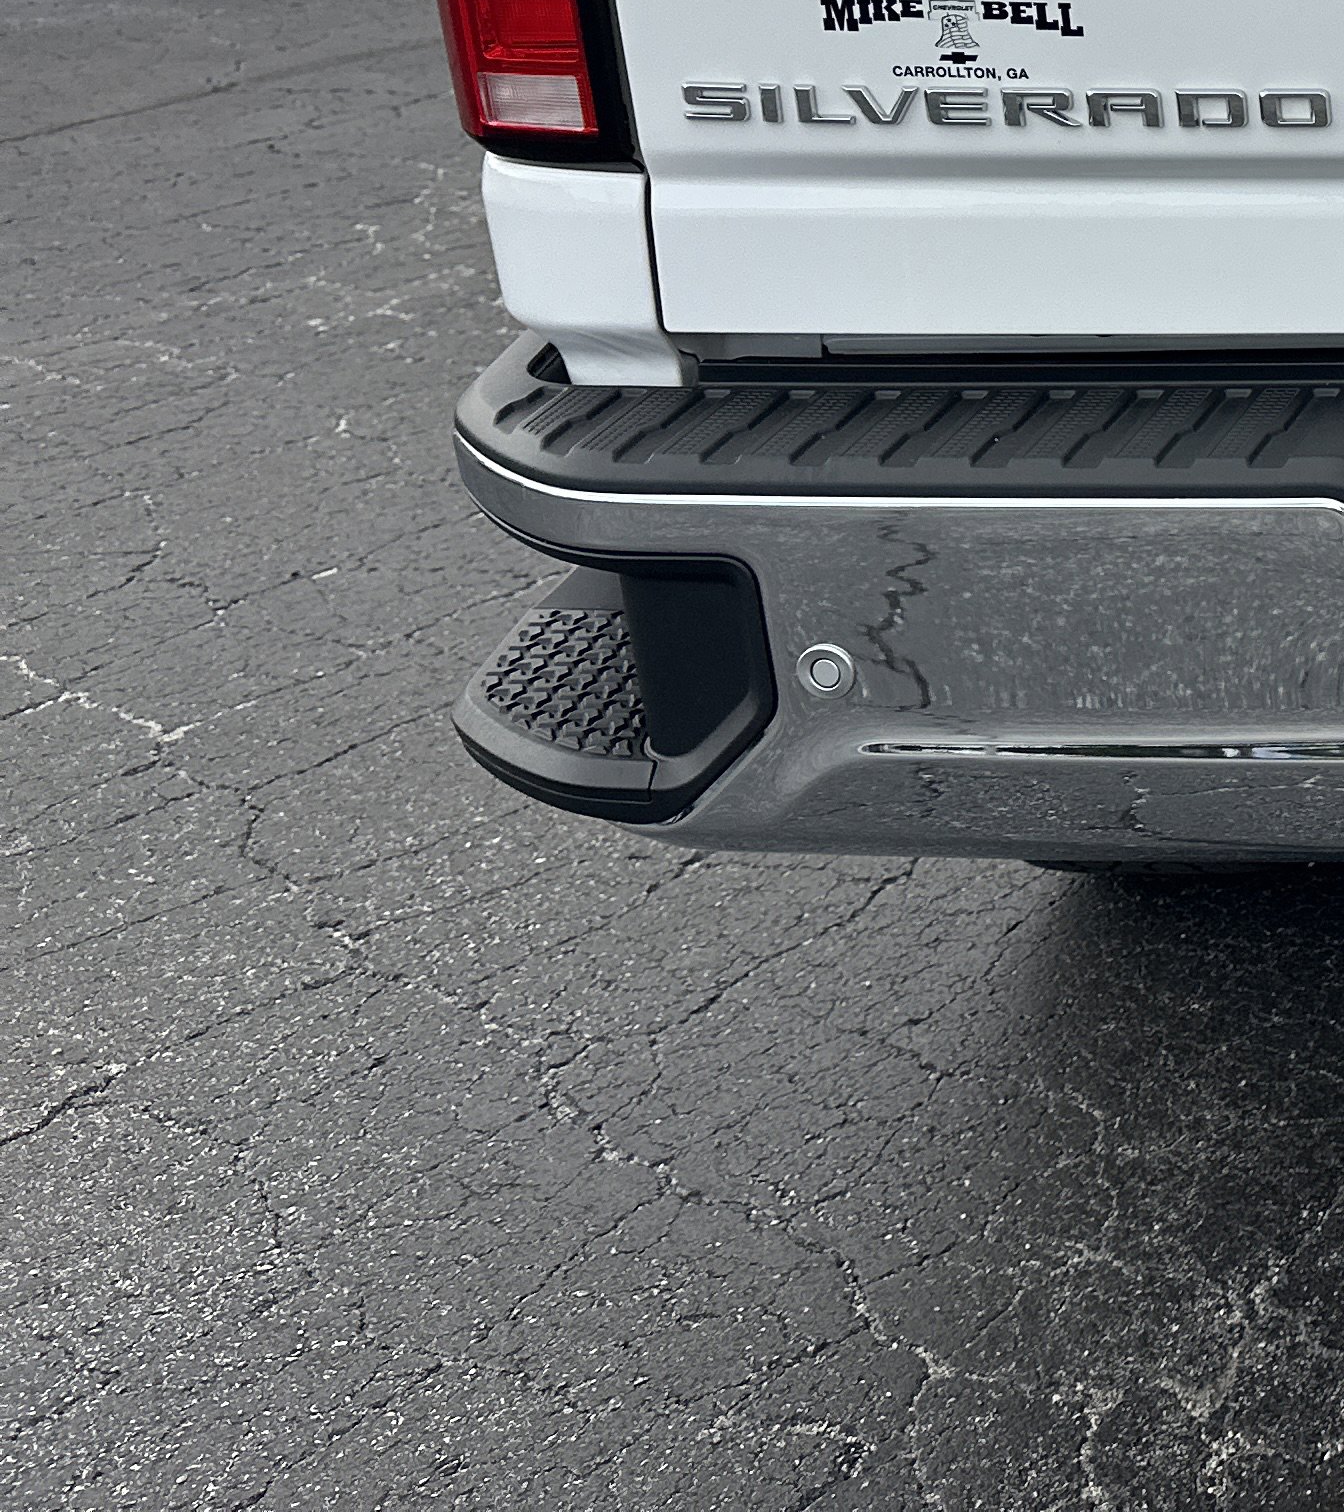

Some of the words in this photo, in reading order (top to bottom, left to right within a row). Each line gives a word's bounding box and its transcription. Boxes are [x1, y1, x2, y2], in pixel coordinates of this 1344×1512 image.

[981, 1, 1084, 37] BELL
[892, 65, 1002, 81] CARROLLTON,
[1006, 68, 1029, 80] GA
[682, 82, 1332, 129] SILVERADO
